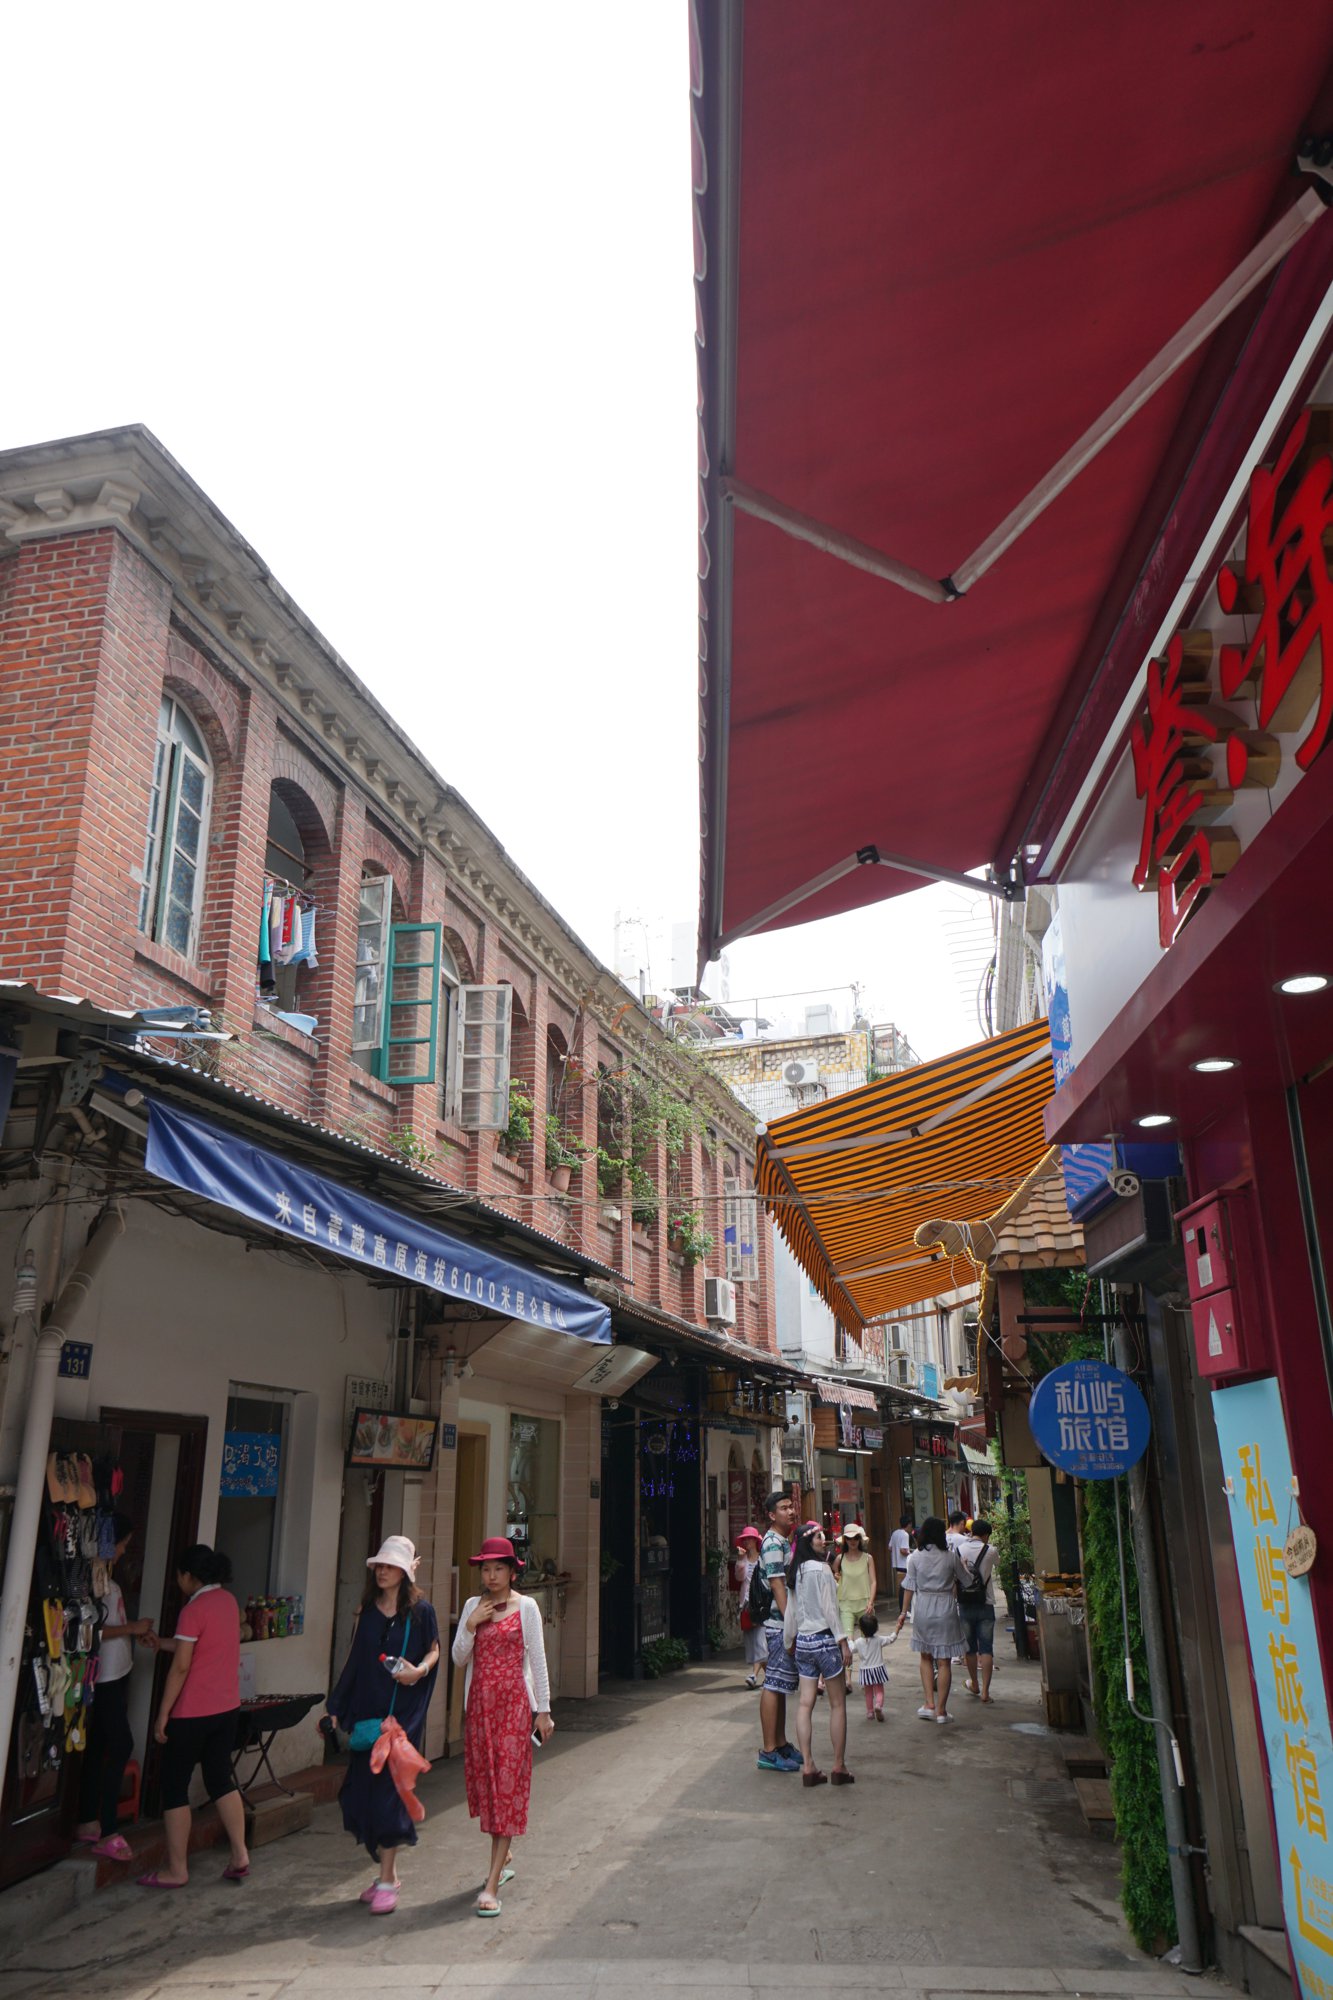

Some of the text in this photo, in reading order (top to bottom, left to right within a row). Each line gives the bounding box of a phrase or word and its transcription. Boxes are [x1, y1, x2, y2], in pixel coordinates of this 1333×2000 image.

[67, 1357, 84, 1374] 131
[1055, 1380, 1125, 1414] 私屿
[1058, 1416, 1129, 1450] 旅馆
[223, 1443, 278, 1467] 口渴了吗
[1237, 1442, 1328, 1844] 私屿旅馆
